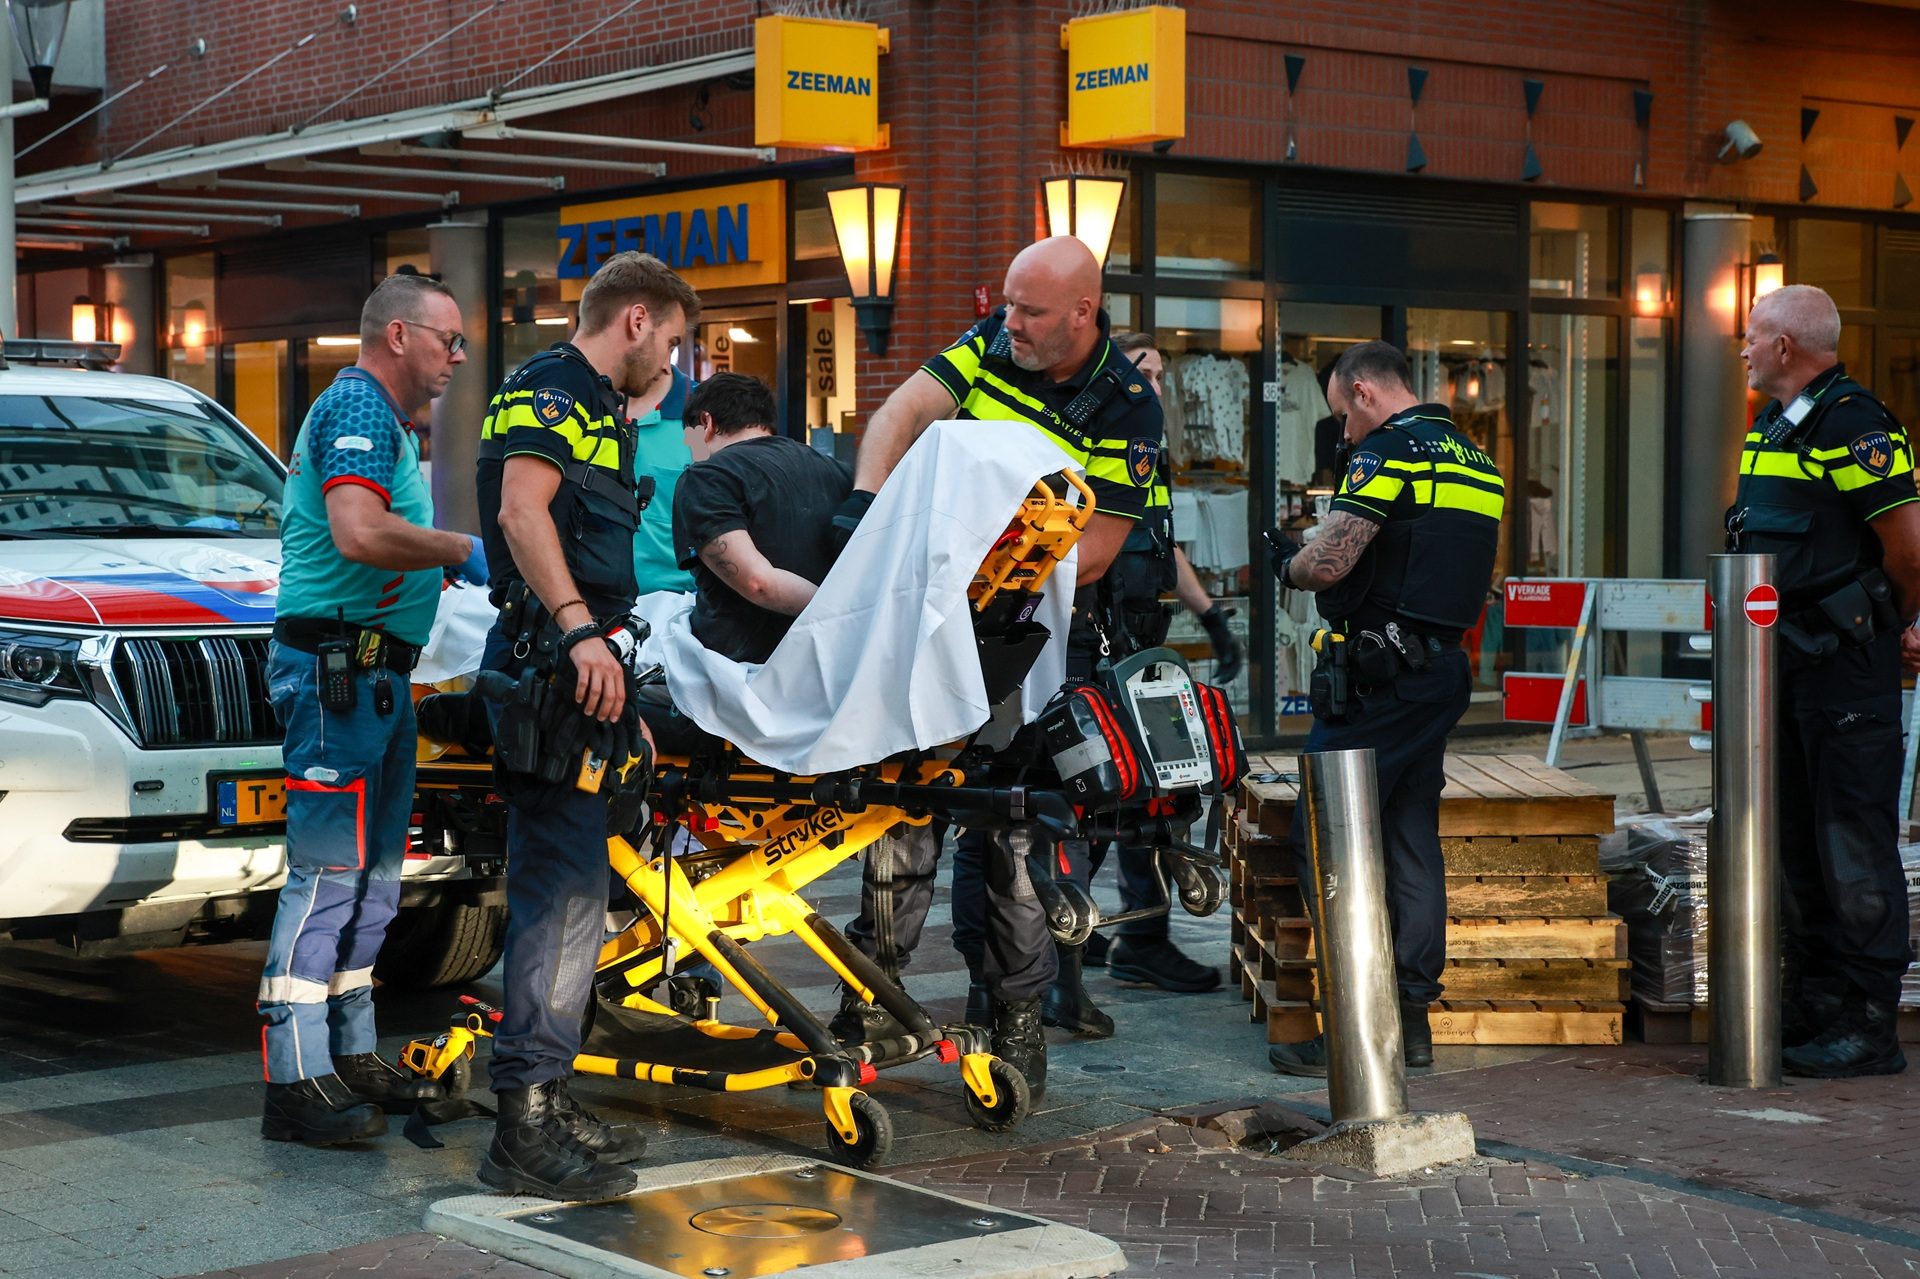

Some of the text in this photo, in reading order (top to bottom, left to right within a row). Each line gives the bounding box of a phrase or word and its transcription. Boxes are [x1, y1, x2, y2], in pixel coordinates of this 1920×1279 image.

[787, 71, 871, 96] ZEEMAN
[1075, 63, 1149, 91] ZEEMAN
[557, 203, 749, 279] ZEEMAN
[712, 336, 730, 373] ale
[813, 328, 834, 391] sale
[538, 392, 570, 405] POLITIE
[1264, 384, 1277, 400] 36
[1050, 412, 1081, 436] POITIE
[1439, 440, 1496, 468] POLITIE
[1855, 436, 1887, 451] POLITIE
[1352, 457, 1377, 466] POLITIE
[1517, 584, 1551, 595] VERKADE
[221, 808, 235, 817] NL
[764, 800, 844, 867] stryker
